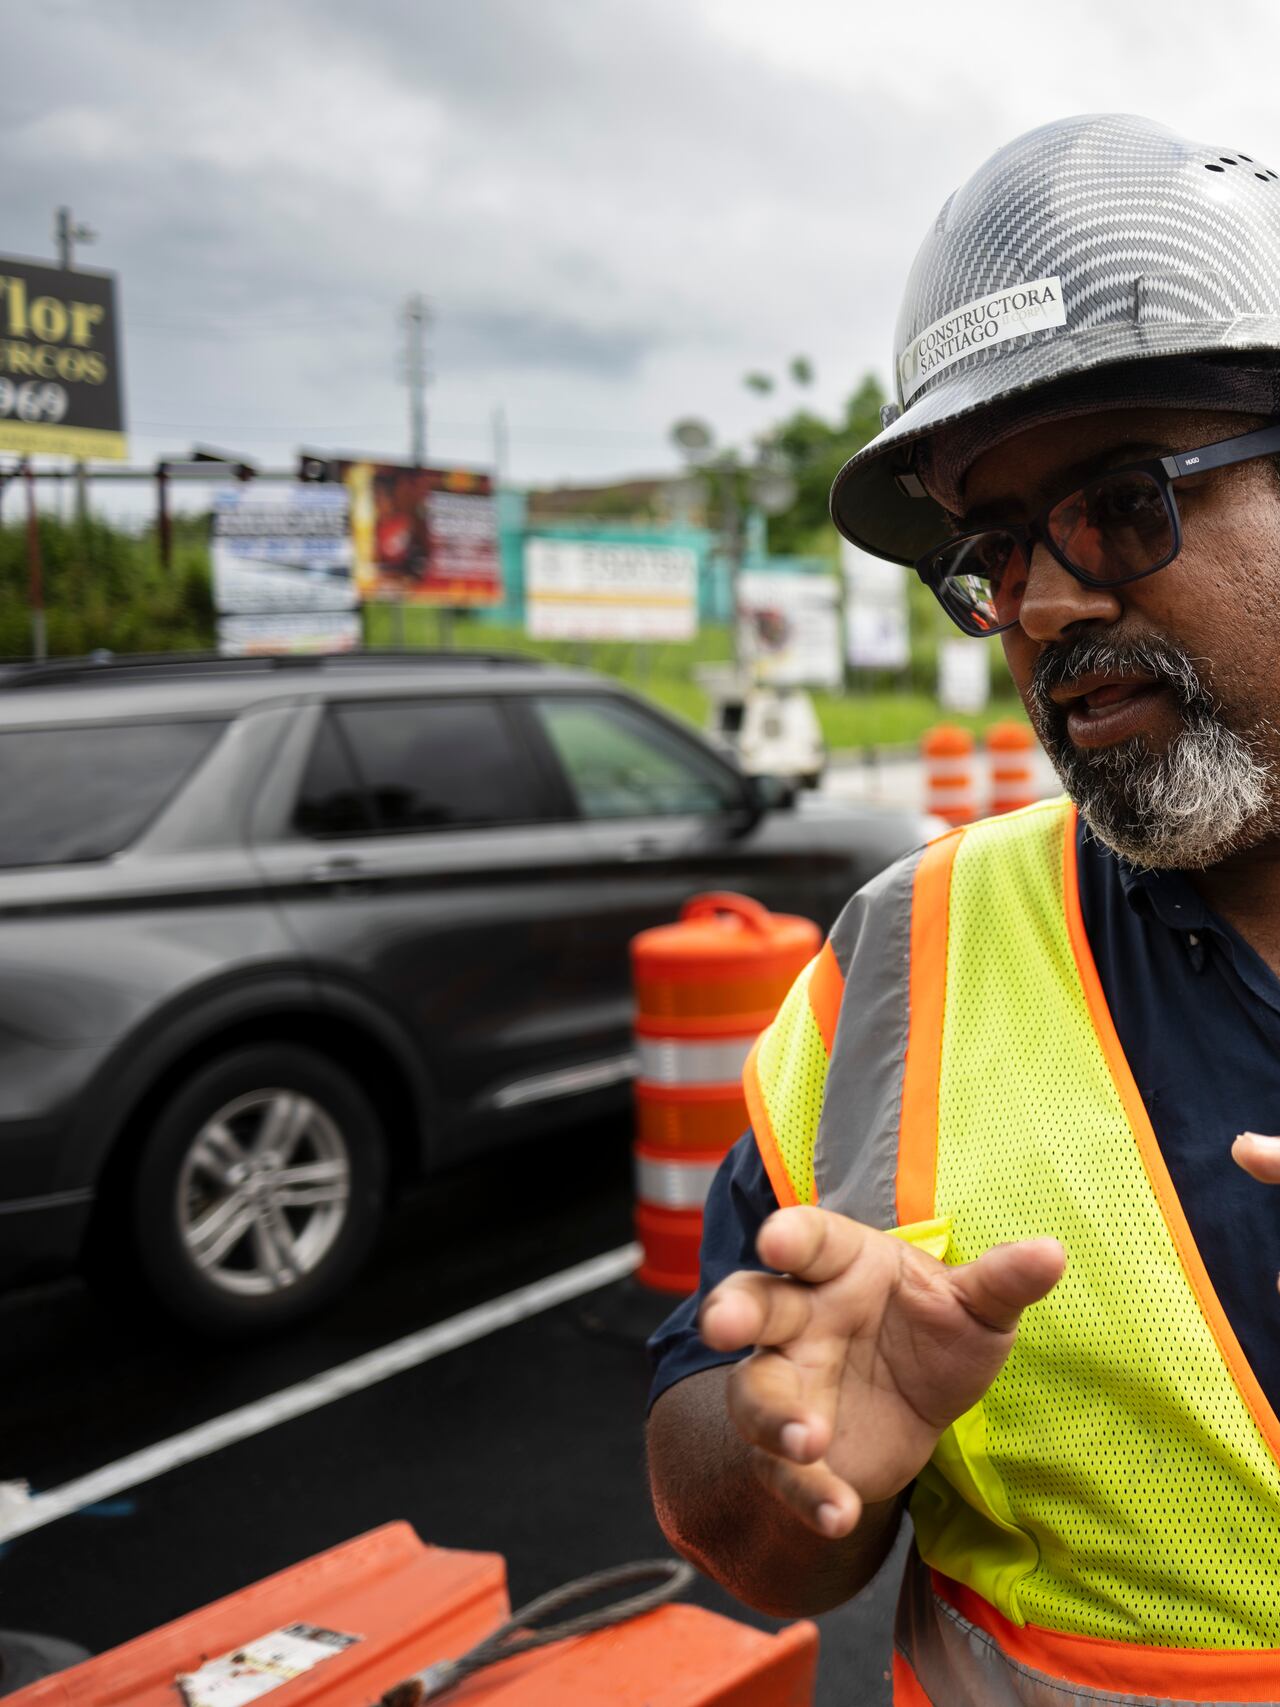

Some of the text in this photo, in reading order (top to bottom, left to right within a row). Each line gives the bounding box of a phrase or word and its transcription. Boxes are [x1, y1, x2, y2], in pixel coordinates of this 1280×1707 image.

[0, 275, 105, 347] lor
[918, 286, 1056, 357] CONSTRUCTORA
[0, 337, 107, 386] RCOS
[920, 320, 998, 376] SANTIAGO
[1185, 456, 1200, 466] HUGO
